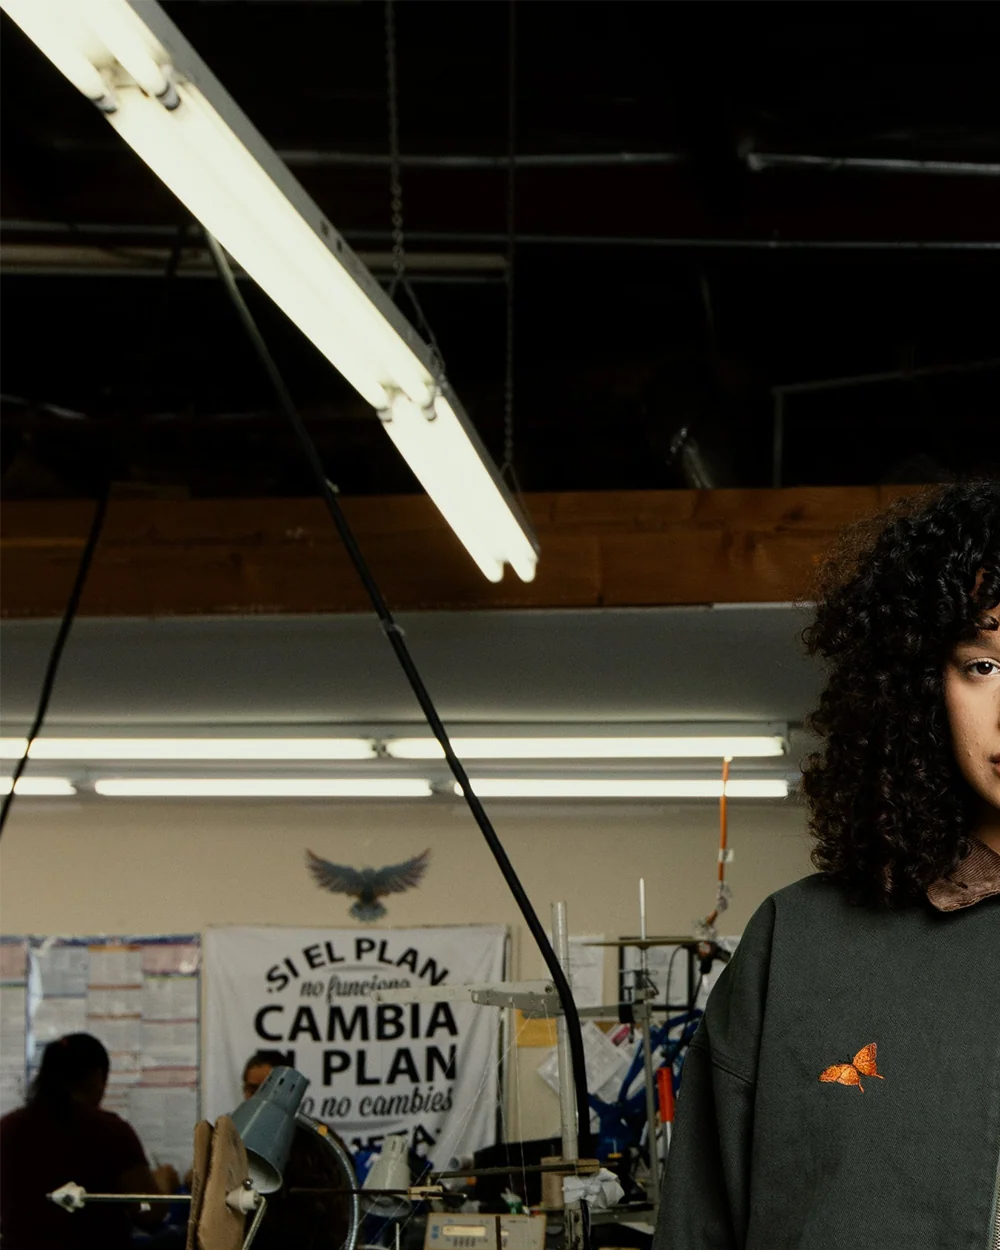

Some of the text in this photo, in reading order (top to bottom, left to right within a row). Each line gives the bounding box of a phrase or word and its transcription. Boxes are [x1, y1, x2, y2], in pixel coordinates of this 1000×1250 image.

[265, 937, 450, 992] SI EL PLAN
[300, 979, 324, 997] no
[254, 1002, 458, 1042] CAMBIA
[323, 1044, 457, 1086] PLAN
[320, 1098, 350, 1117] no
[359, 1086, 454, 1117] cambies
